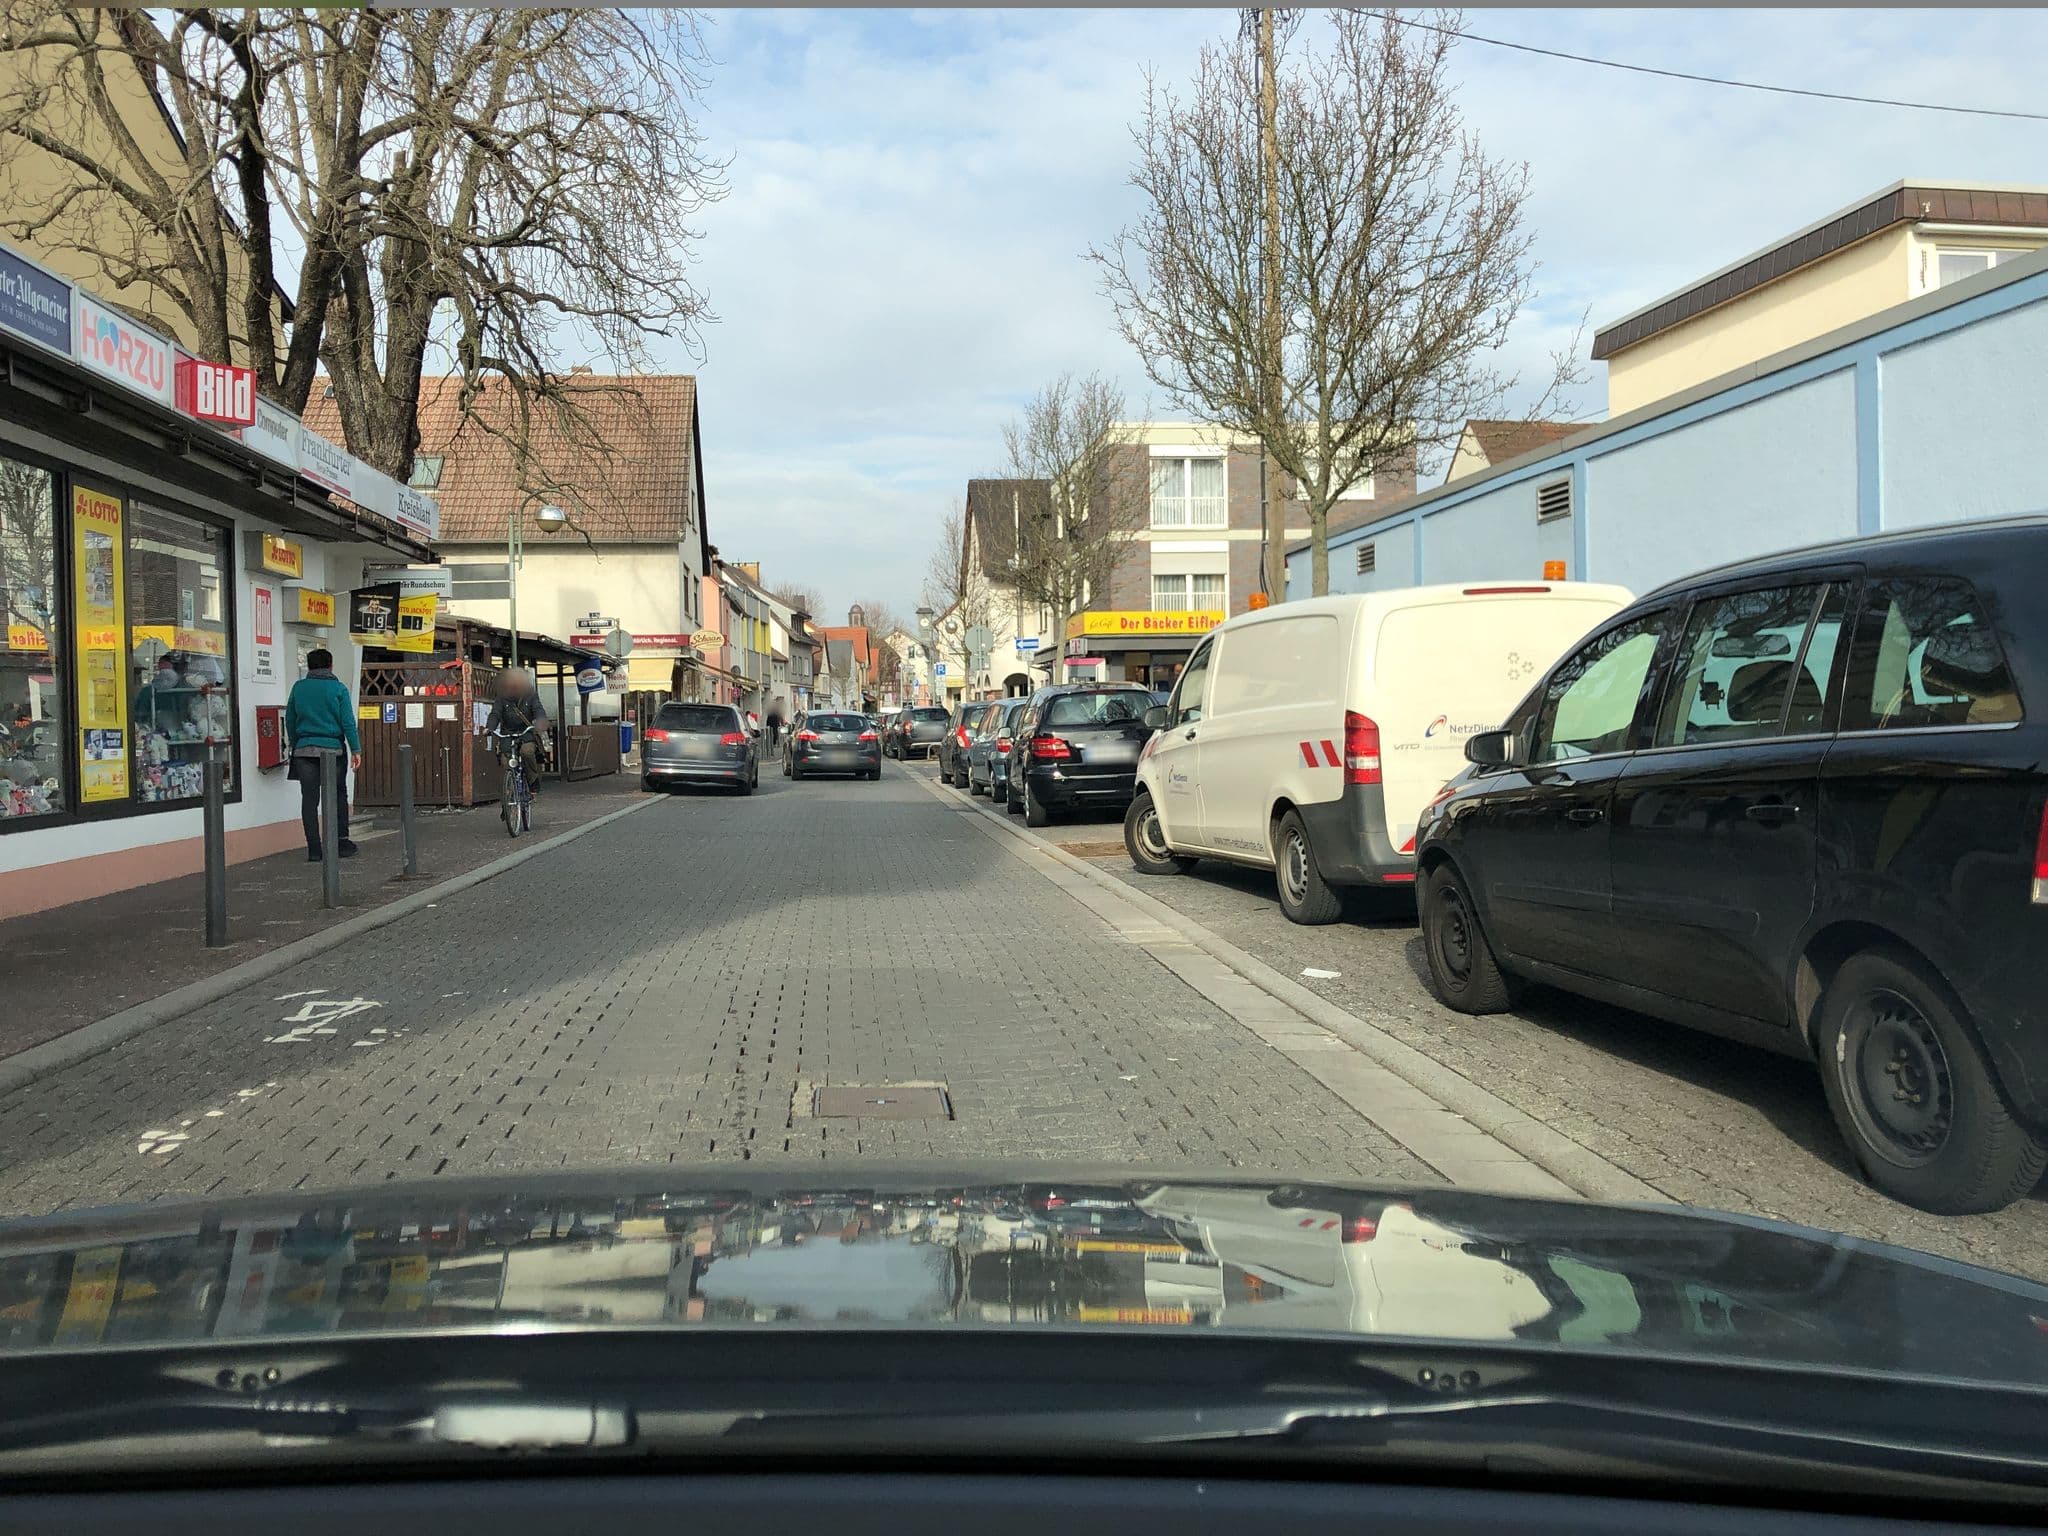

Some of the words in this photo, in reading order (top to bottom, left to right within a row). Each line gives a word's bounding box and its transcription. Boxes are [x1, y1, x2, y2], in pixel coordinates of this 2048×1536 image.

[16, 274, 67, 323] Allgemeine
[197, 364, 251, 421] Bild
[302, 429, 351, 476] Frankfurter
[89, 499, 119, 524] LOTTO
[398, 493, 431, 525] Kreisblatt
[278, 549, 295, 566] LOTTO
[410, 580, 445, 589] Rundschau
[313, 599, 329, 616] LOTTO
[1121, 617, 1140, 630] Der
[1144, 616, 1184, 630] Bäcker
[1188, 615, 1222, 630] Eifler
[608, 683, 626, 691] Wurst
[386, 704, 394, 713] P
